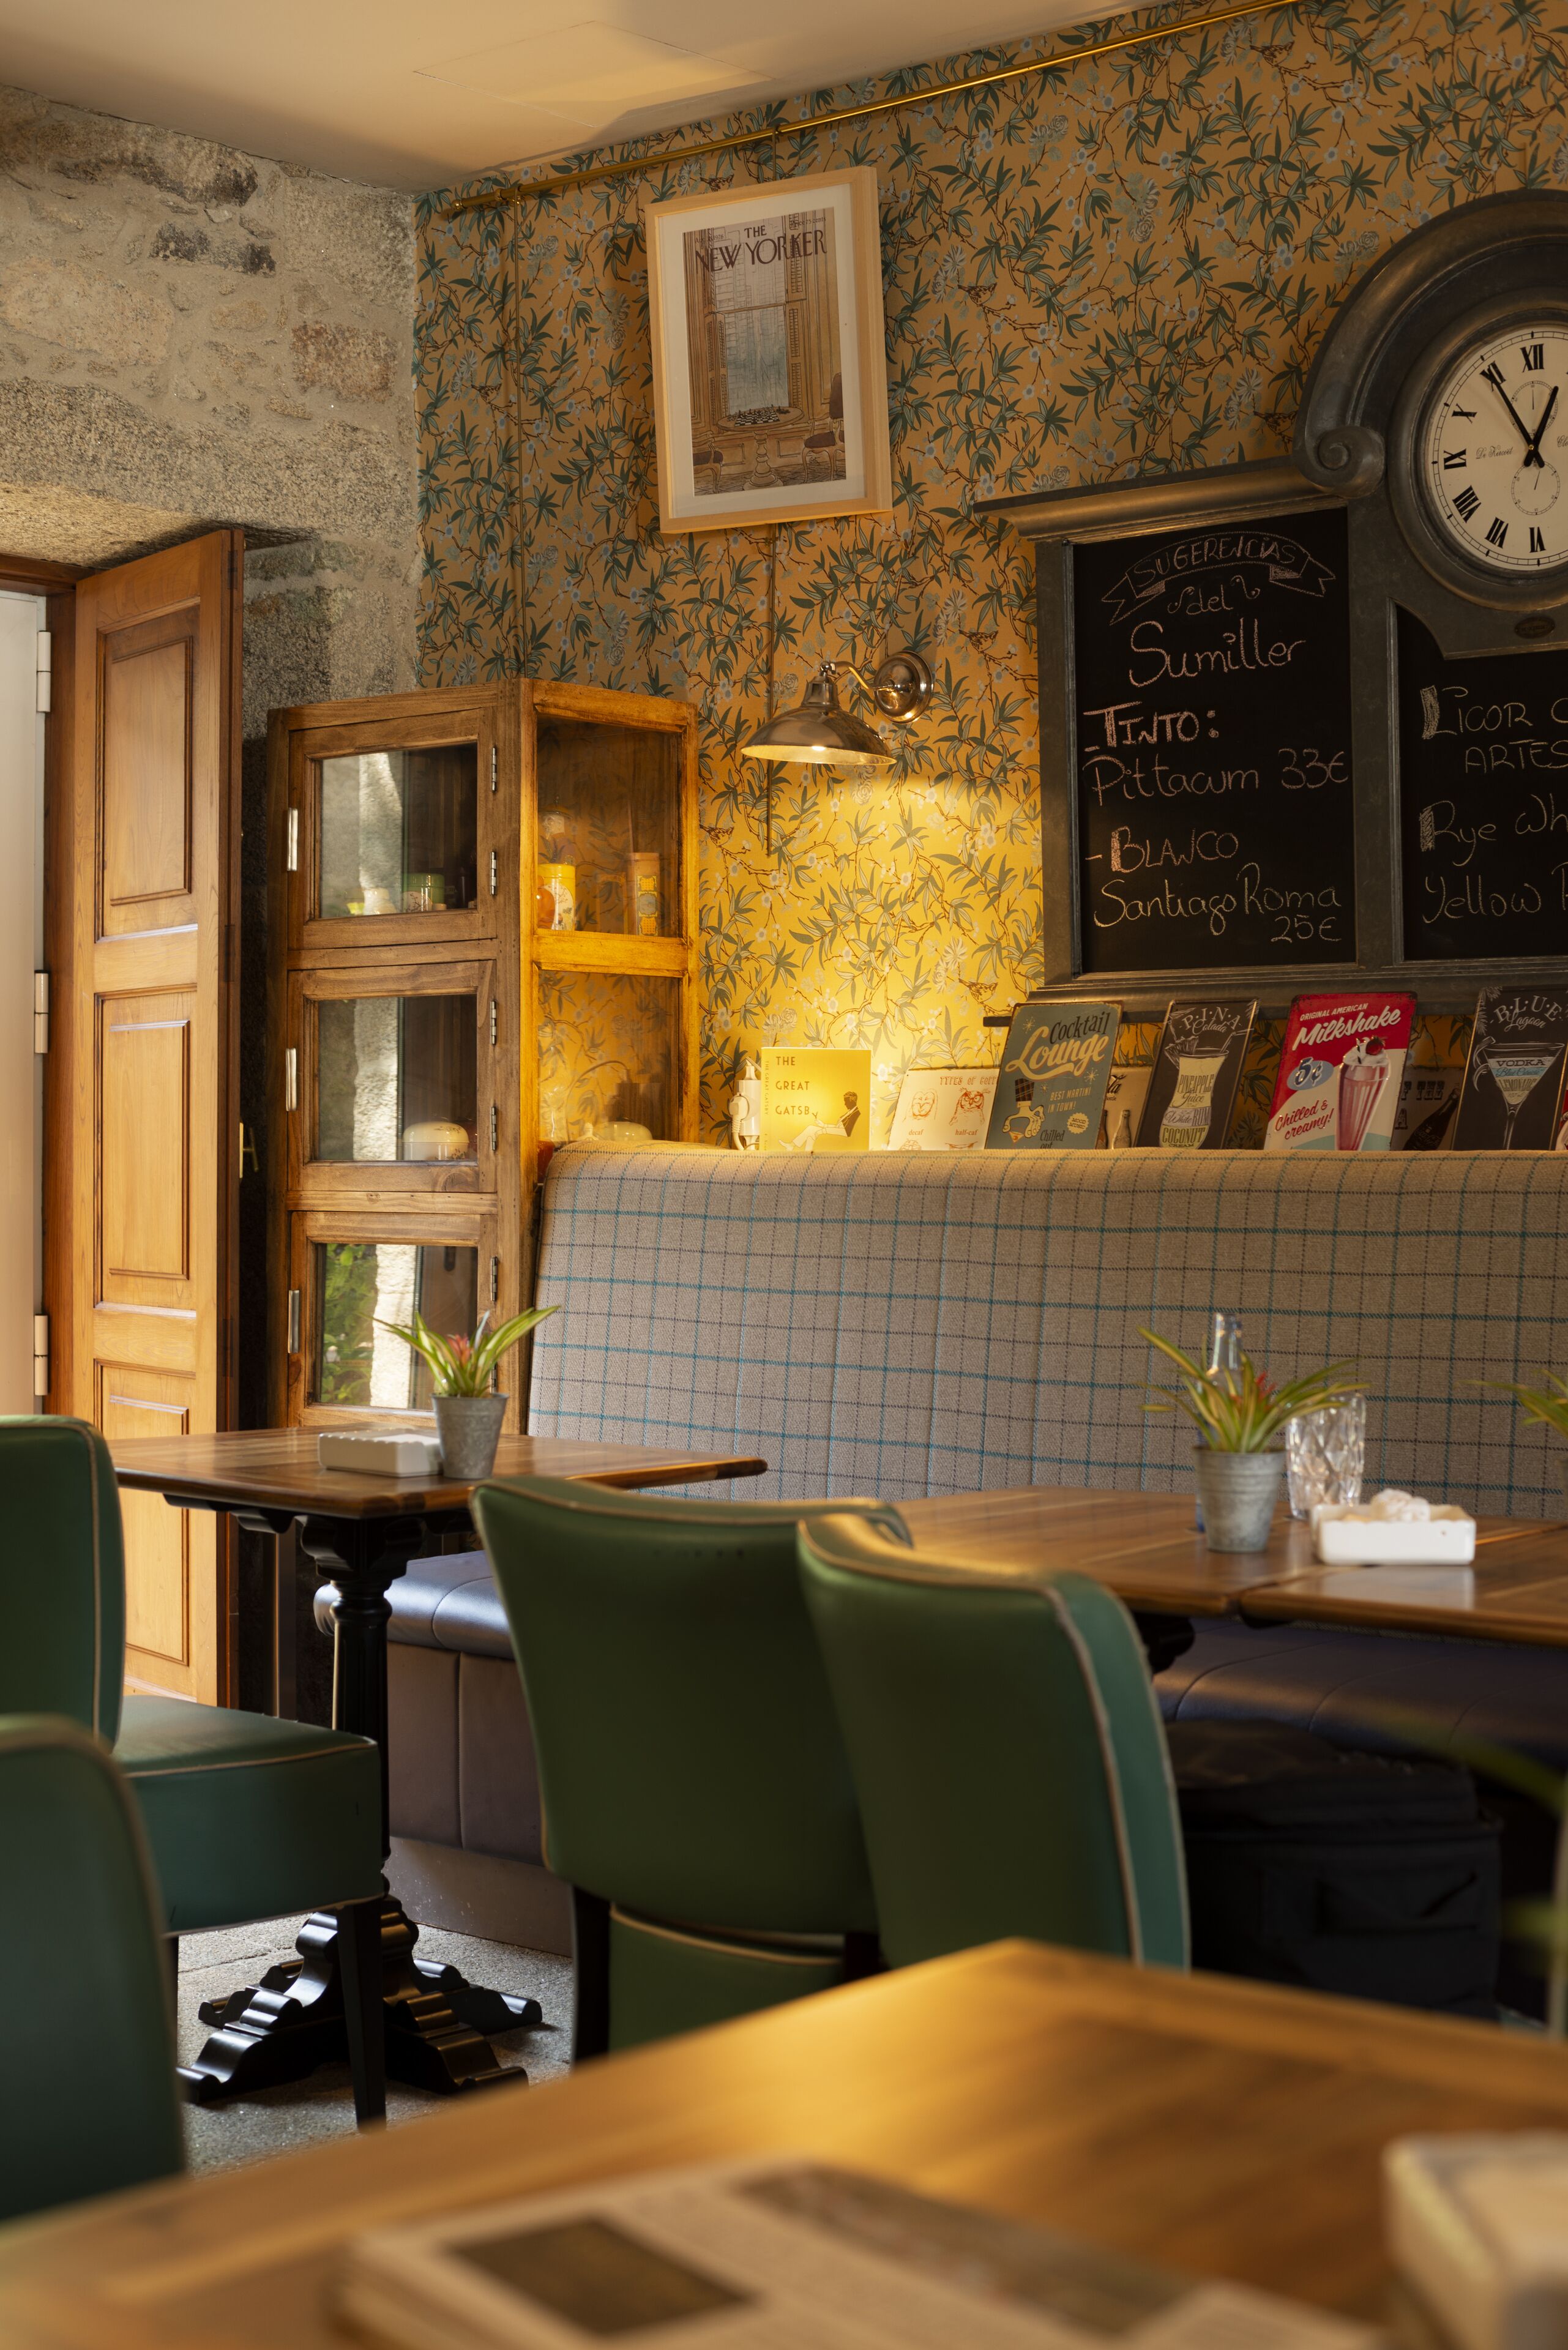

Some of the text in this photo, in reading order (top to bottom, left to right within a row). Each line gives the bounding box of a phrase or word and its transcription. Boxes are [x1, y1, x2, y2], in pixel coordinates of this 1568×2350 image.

[744, 225, 767, 239] THE
[695, 229, 827, 274] NEW YORKER
[1520, 343, 1544, 372] XII
[1452, 403, 1477, 423] X
[1444, 449, 1467, 470] IX
[1452, 485, 1481, 523] VIII
[1484, 517, 1509, 548] VII
[1529, 527, 1546, 553] VI
[1134, 535, 1296, 588] SUGERENCIAS
[1186, 584, 1233, 615] del
[1129, 617, 1307, 688] Sumiller
[1421, 685, 1533, 739] LICOR
[1082, 748, 1349, 806] Pittacum 33€
[1419, 800, 1497, 866] Rye
[1094, 862, 1342, 936] Santiago Roma
[1423, 875, 1542, 923] Yellow
[1271, 914, 1342, 943] 25€
[1300, 1003, 1368, 1021] ORIGINAL AMERICAN
[1504, 1010, 1547, 1032] Lagoon
[1050, 1011, 1111, 1044] Cocktail
[1192, 1019, 1227, 1035] Colada
[1292, 1005, 1401, 1051] Milkshake
[775, 1056, 796, 1065] THE
[1005, 1026, 1110, 1081] Lounge
[1496, 1058, 1547, 1067] VODKA
[775, 1081, 810, 1090] GREAT
[1177, 1074, 1214, 1094] PINEAPPLE
[1294, 1056, 1323, 1087] 5¢
[1050, 1087, 1091, 1101] BEST MARTINI
[1056, 1101, 1076, 1111] TOWN!
[1171, 1091, 1204, 1107] Juice
[775, 1105, 818, 1119] GATSBY
[1165, 1107, 1211, 1127] White RUM
[1274, 1100, 1328, 1132] Chilled &
[1285, 1108, 1335, 1140] creamy!
[1040, 1129, 1065, 1141] Chilled
[1162, 1127, 1206, 1144] COCONUT
